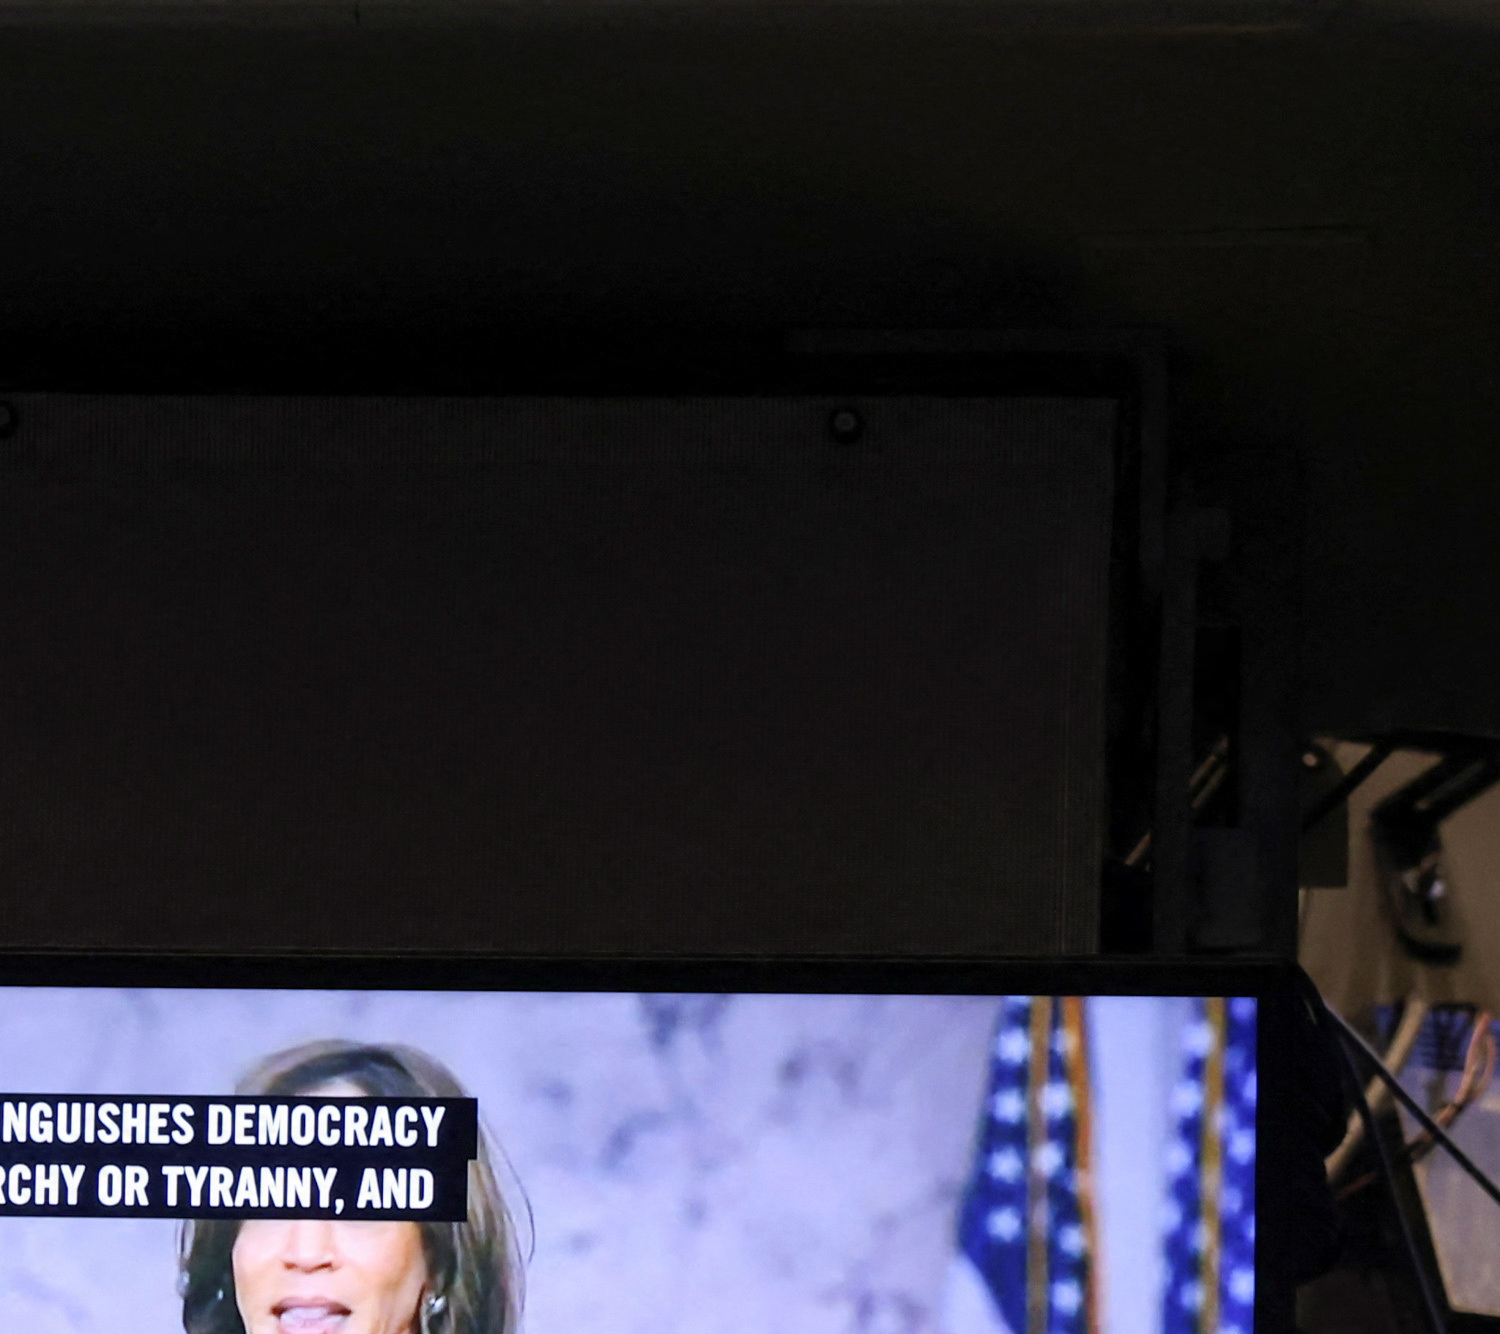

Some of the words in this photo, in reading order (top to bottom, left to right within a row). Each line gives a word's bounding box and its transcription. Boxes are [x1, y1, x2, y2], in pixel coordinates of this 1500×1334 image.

[207, 1104, 446, 1148] DEMOCRACY
[97, 1165, 149, 1206] OR
[161, 1165, 345, 1212] TYRANNY,
[357, 1167, 434, 1209] AND
